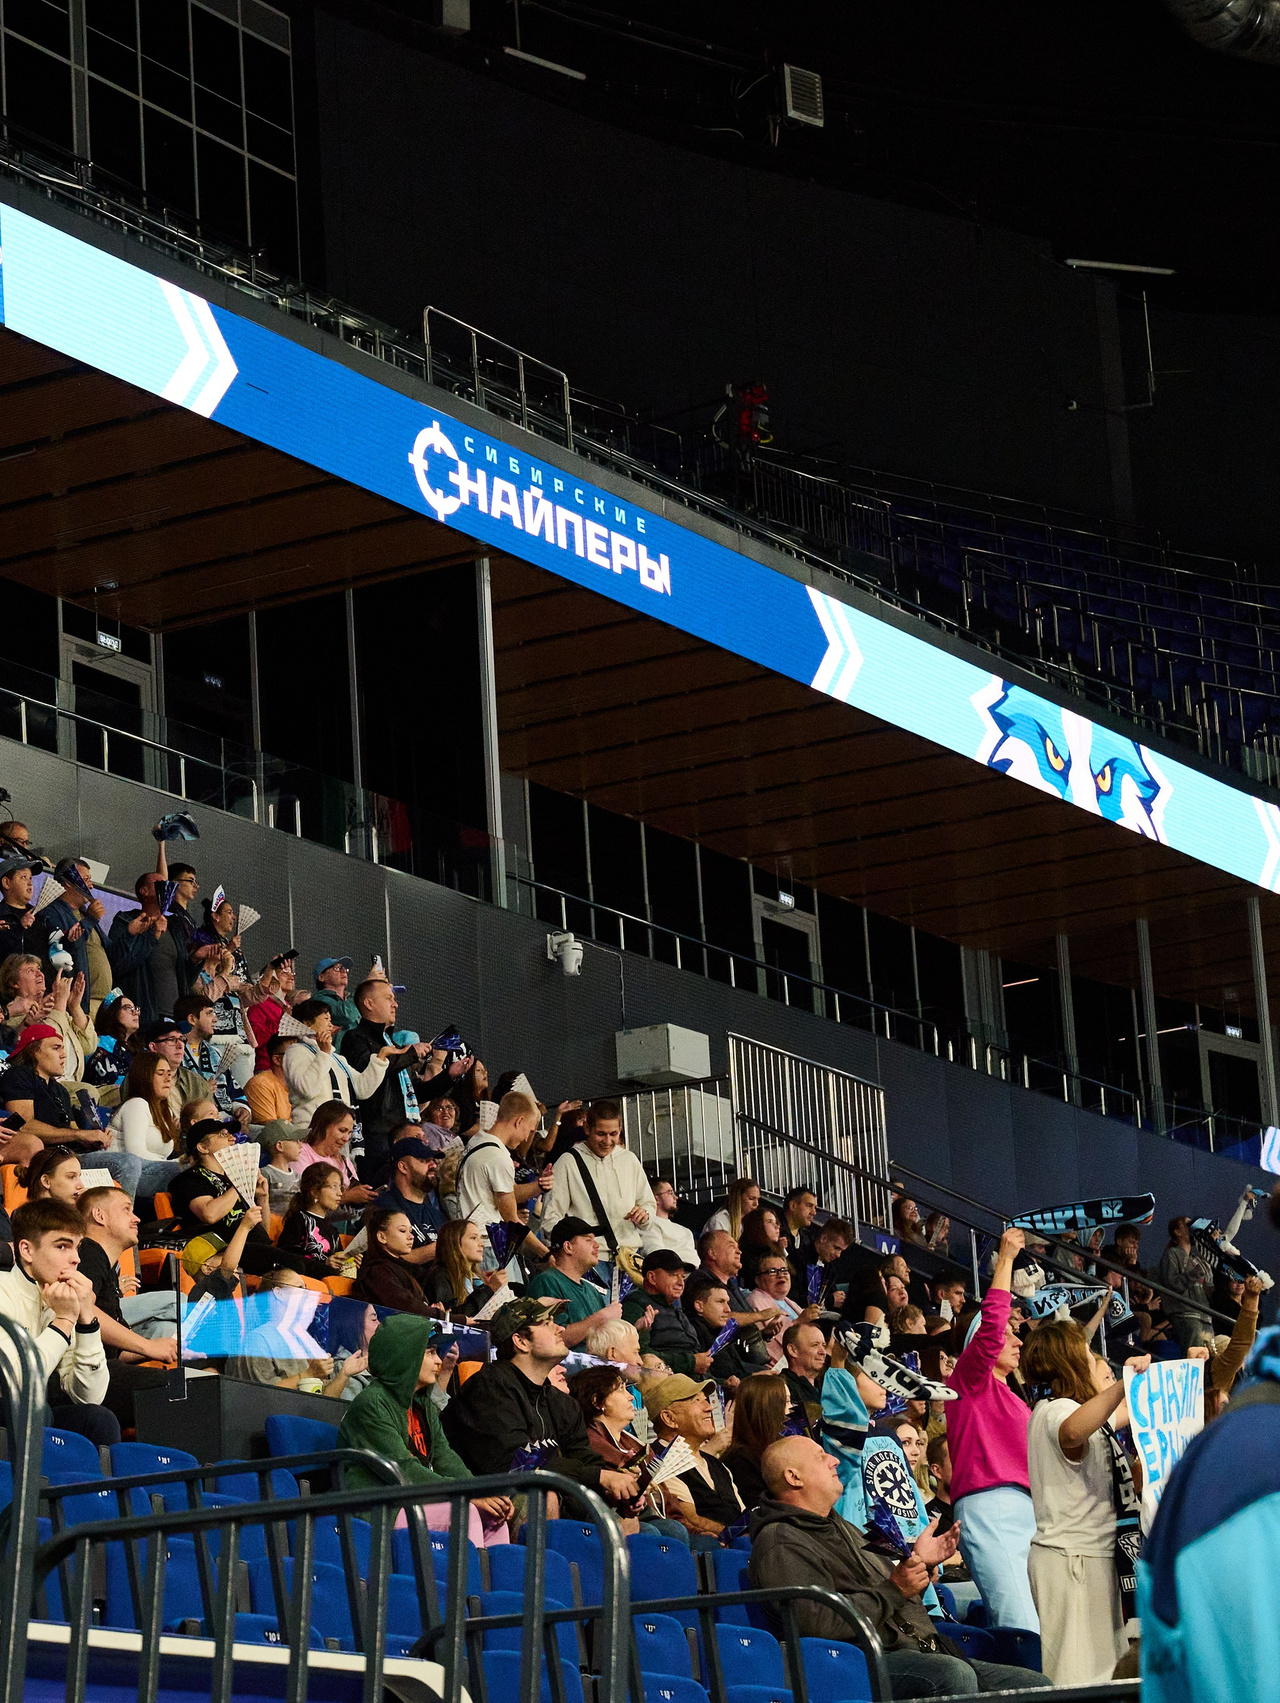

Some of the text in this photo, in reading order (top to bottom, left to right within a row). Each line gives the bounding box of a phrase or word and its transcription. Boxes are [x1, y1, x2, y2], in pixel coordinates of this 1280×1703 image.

[464, 436, 646, 534] СИБИРСКИЕ
[407, 420, 672, 597] СНАЙПЕРЫ
[94, 1056, 118, 1078] 84
[1101, 1200, 1124, 1219] 62
[865, 1451, 901, 1485] SIBIR HOCKE
